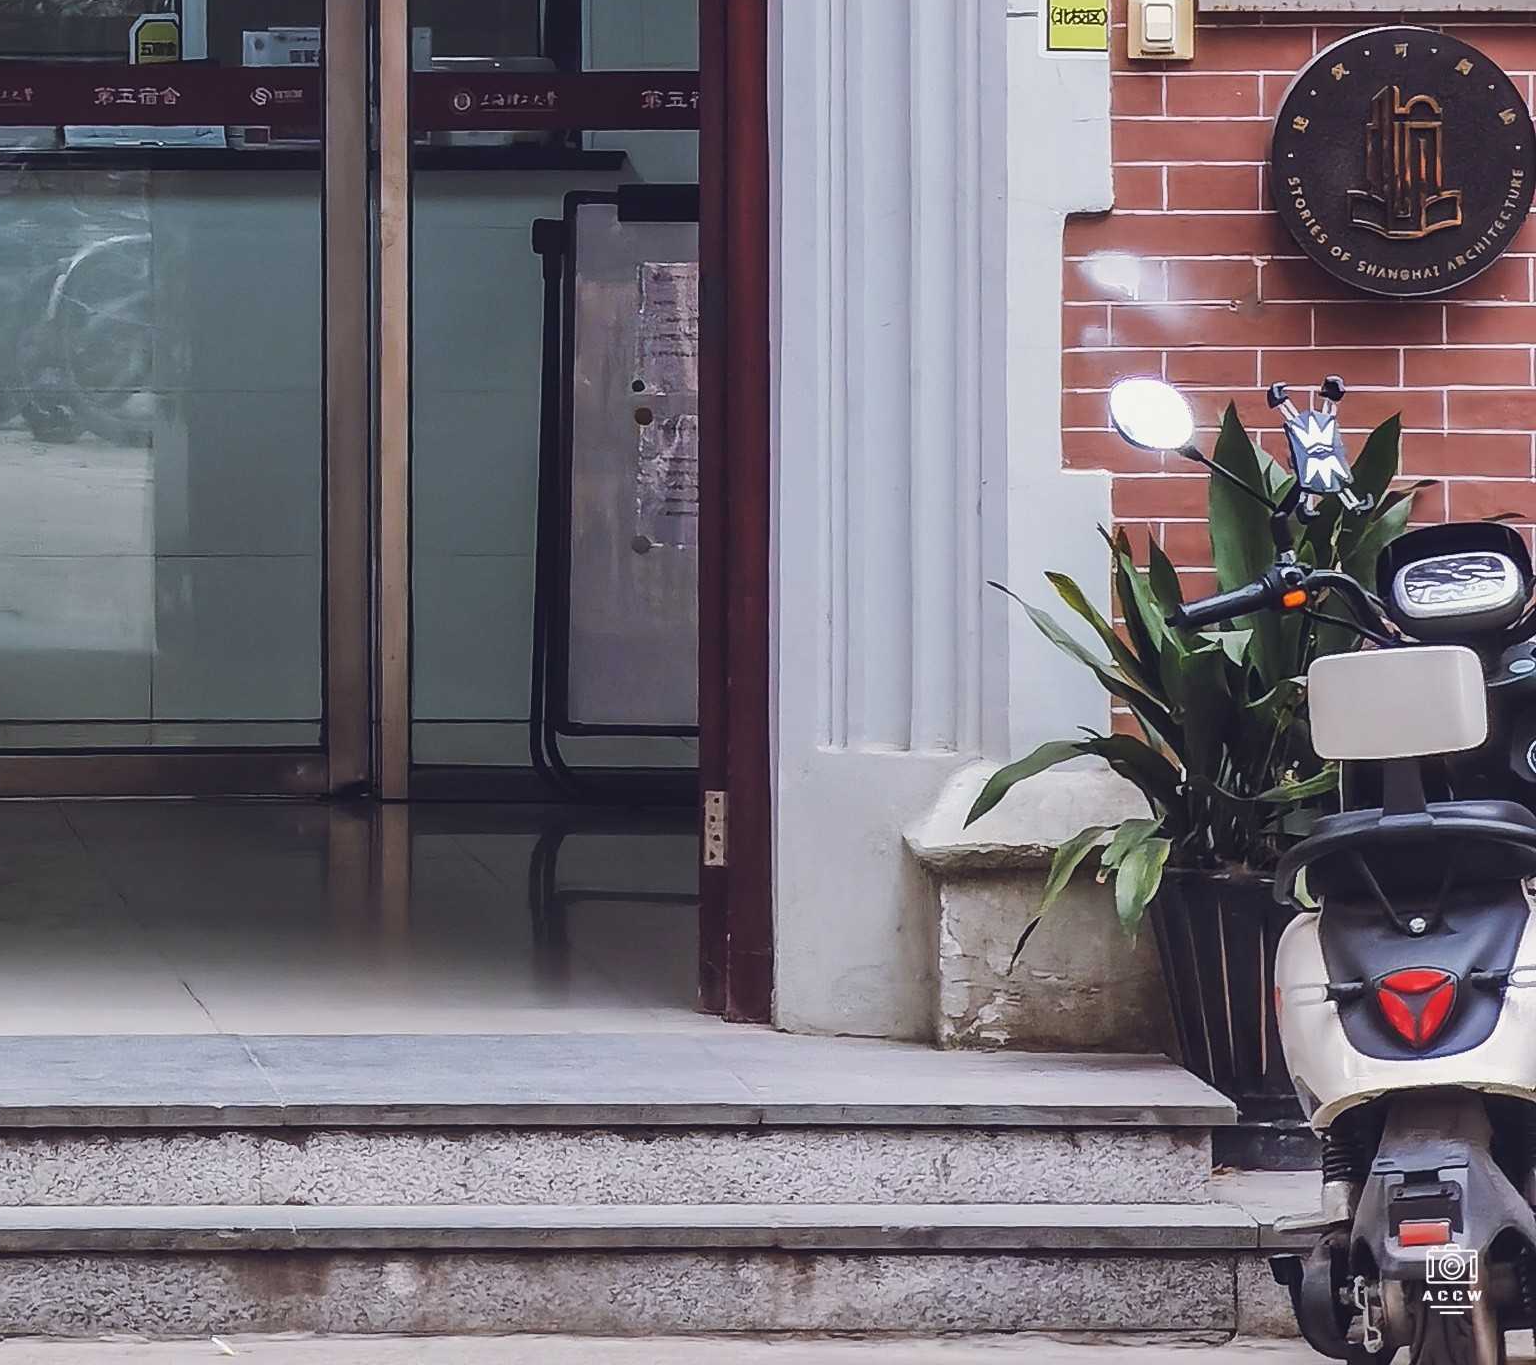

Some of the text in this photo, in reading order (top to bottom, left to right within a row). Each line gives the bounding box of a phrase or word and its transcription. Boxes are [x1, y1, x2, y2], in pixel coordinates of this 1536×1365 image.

[93, 86, 182, 106] 第五宿舍
[1287, 168, 1524, 281] STORIES OF SHANGHAI ARCHITECTURE
